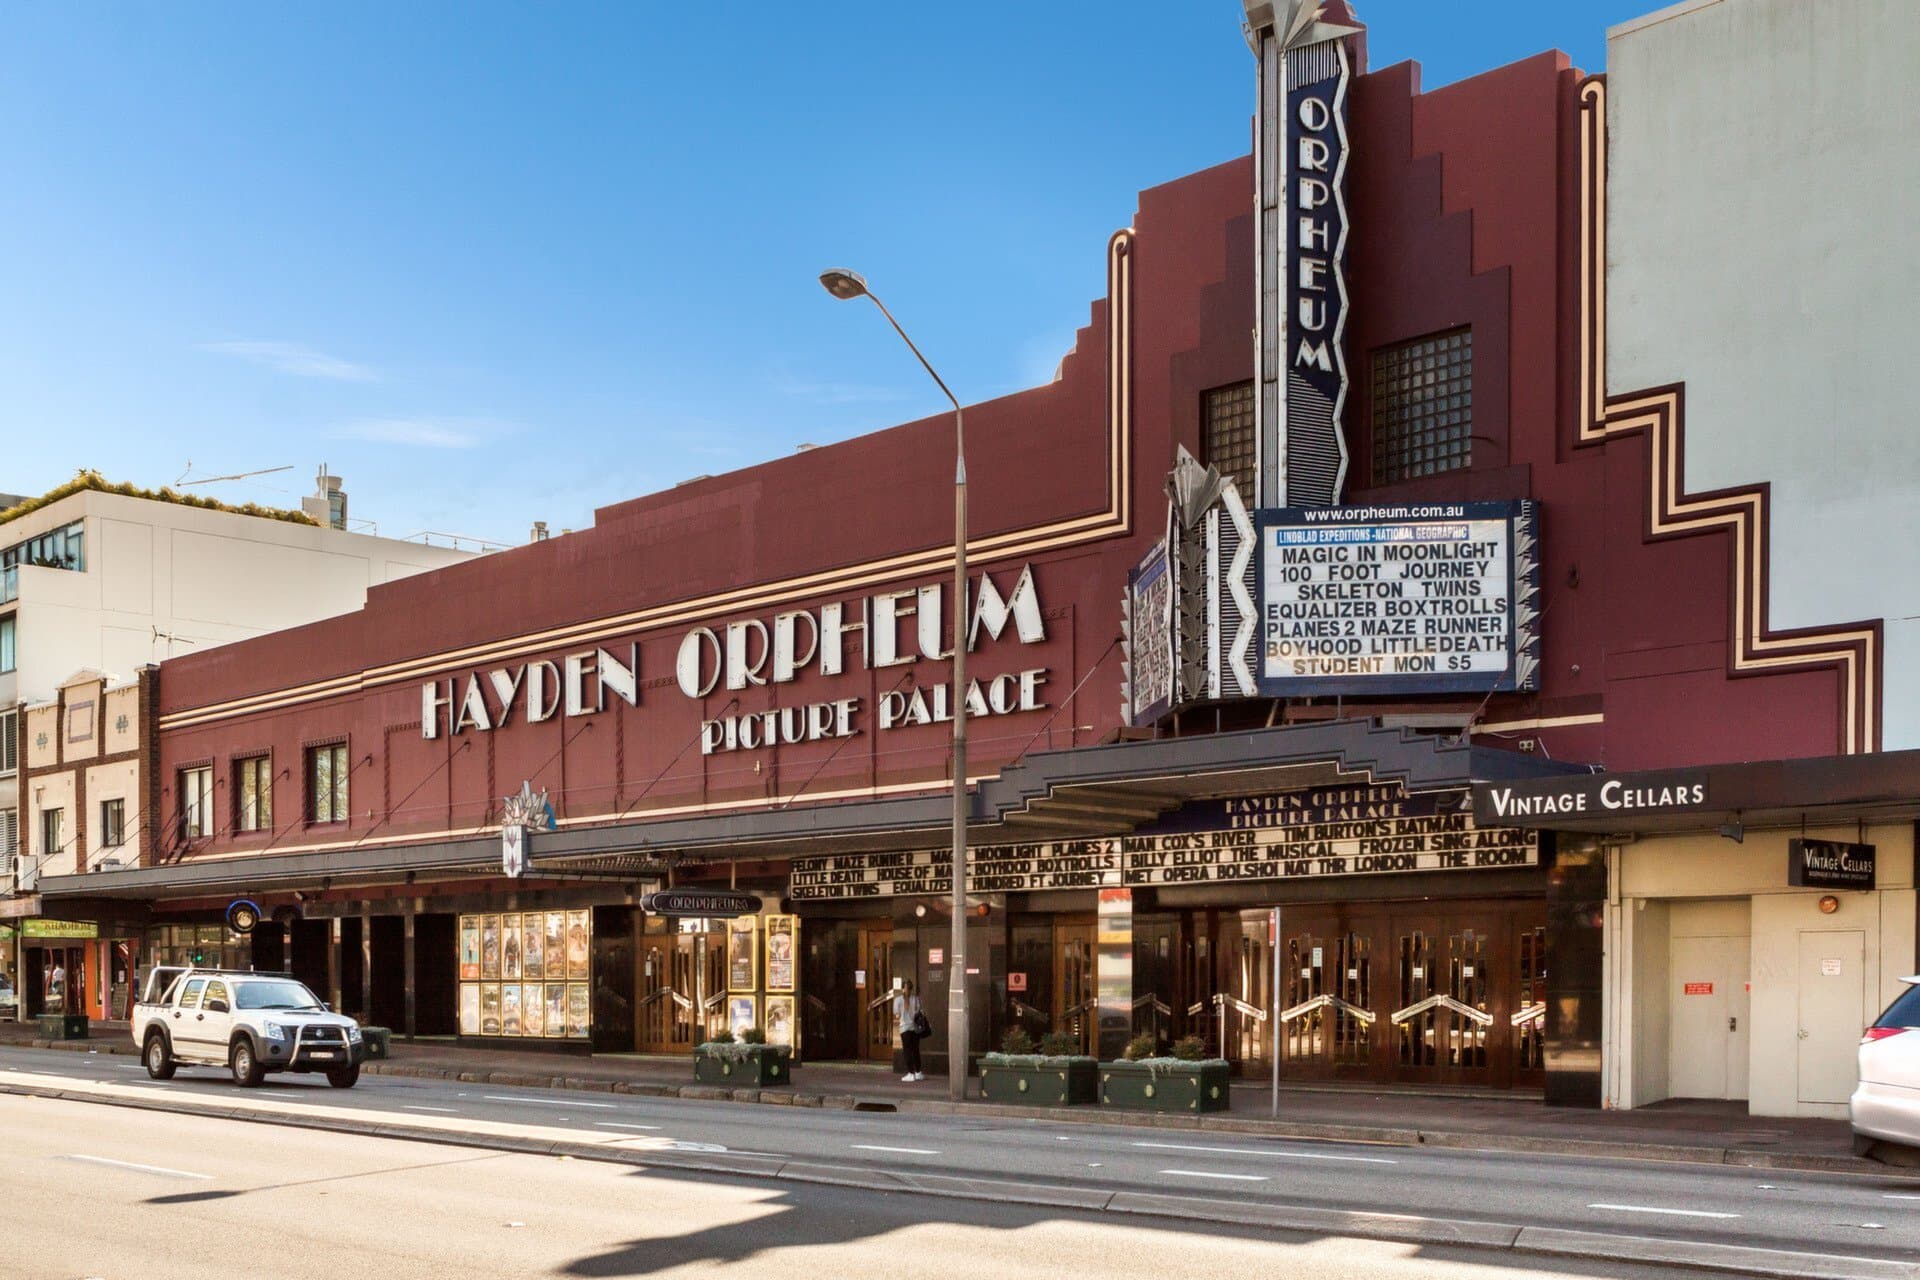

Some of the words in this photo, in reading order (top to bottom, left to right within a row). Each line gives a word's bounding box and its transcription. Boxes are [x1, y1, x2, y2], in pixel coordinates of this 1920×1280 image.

[1296, 97, 1333, 372] ORPHEUM
[1304, 506, 1464, 521] www.orpheum.com.au
[1320, 528, 1370, 542] EXPEDITIONS
[1416, 526, 1468, 540] GEOGRAPHIC
[1282, 546, 1348, 564] MAGIC
[1357, 546, 1376, 562] IN
[1384, 542, 1498, 560] MOONLIGHT
[1280, 566, 1312, 582] 100
[1328, 564, 1382, 580] FOOT
[1400, 561, 1490, 579] JOURNEY
[1298, 582, 1403, 600] SKELETON
[1421, 580, 1482, 598] TWINS
[1267, 601, 1376, 619] EQUALIZER
[1385, 598, 1507, 616] BOXTROLLS
[1266, 621, 1340, 638] PLANES
[1344, 620, 1356, 636] 2
[1361, 619, 1416, 636] MAZE
[1425, 616, 1502, 634] RUNNER
[422, 641, 638, 741] HAYDEN
[676, 562, 1046, 700] ORPHEUM
[1266, 639, 1362, 657] BOYHOOD
[1371, 636, 1436, 654] LITTLE
[1439, 634, 1508, 652] DEATH
[1293, 657, 1383, 674] STUDENT
[1394, 656, 1435, 672] MON
[702, 697, 860, 756] PICTURE
[880, 668, 1048, 730] PALACE
[1226, 795, 1301, 814] HAYDEN
[1312, 787, 1411, 807] ORPHEUM
[1232, 810, 1312, 828] PICTURE
[1324, 802, 1405, 822] PALACE
[1125, 837, 1156, 852] MAN
[1162, 834, 1205, 850] COX'S
[1212, 830, 1257, 848] RIVER
[1283, 827, 1310, 842] TIM
[1314, 819, 1392, 840] BURTON'S
[1396, 815, 1466, 834] BATMAN
[834, 856, 864, 870] MAZE
[868, 853, 914, 868] RUNNER
[974, 844, 1043, 862] MOONLIGHT
[1052, 841, 1102, 857] PLANES
[1105, 840, 1114, 854] 2
[1131, 852, 1168, 868] BILLY
[1173, 849, 1222, 865] ELLIOT
[1230, 847, 1258, 862] THE
[1266, 841, 1336, 860] MUSICAL
[1360, 836, 1425, 855] FROZEN
[1430, 832, 1472, 852] SING
[1476, 829, 1537, 848] ALONG
[792, 872, 828, 886] LITTLE
[830, 870, 864, 884] DEATH
[876, 867, 912, 882] HOUSE
[914, 866, 930, 880] OF
[975, 860, 1031, 876] BOYHOOD
[1038, 855, 1114, 872] BOXTROLLS
[1125, 868, 1154, 884] MET
[1163, 866, 1210, 882] OPERA
[1218, 862, 1278, 879] BOLSHOI
[1284, 860, 1312, 876] NAT
[1317, 857, 1346, 874] THR
[1354, 854, 1417, 872] LONDON
[1436, 850, 1468, 868] THE
[1476, 848, 1527, 866] ROOM
[792, 885, 844, 898] SKELETON
[847, 882, 880, 896] TWINS
[973, 875, 1026, 890] HUNDRED
[1030, 874, 1046, 888] FT
[1048, 871, 1106, 887] JOURNEY
